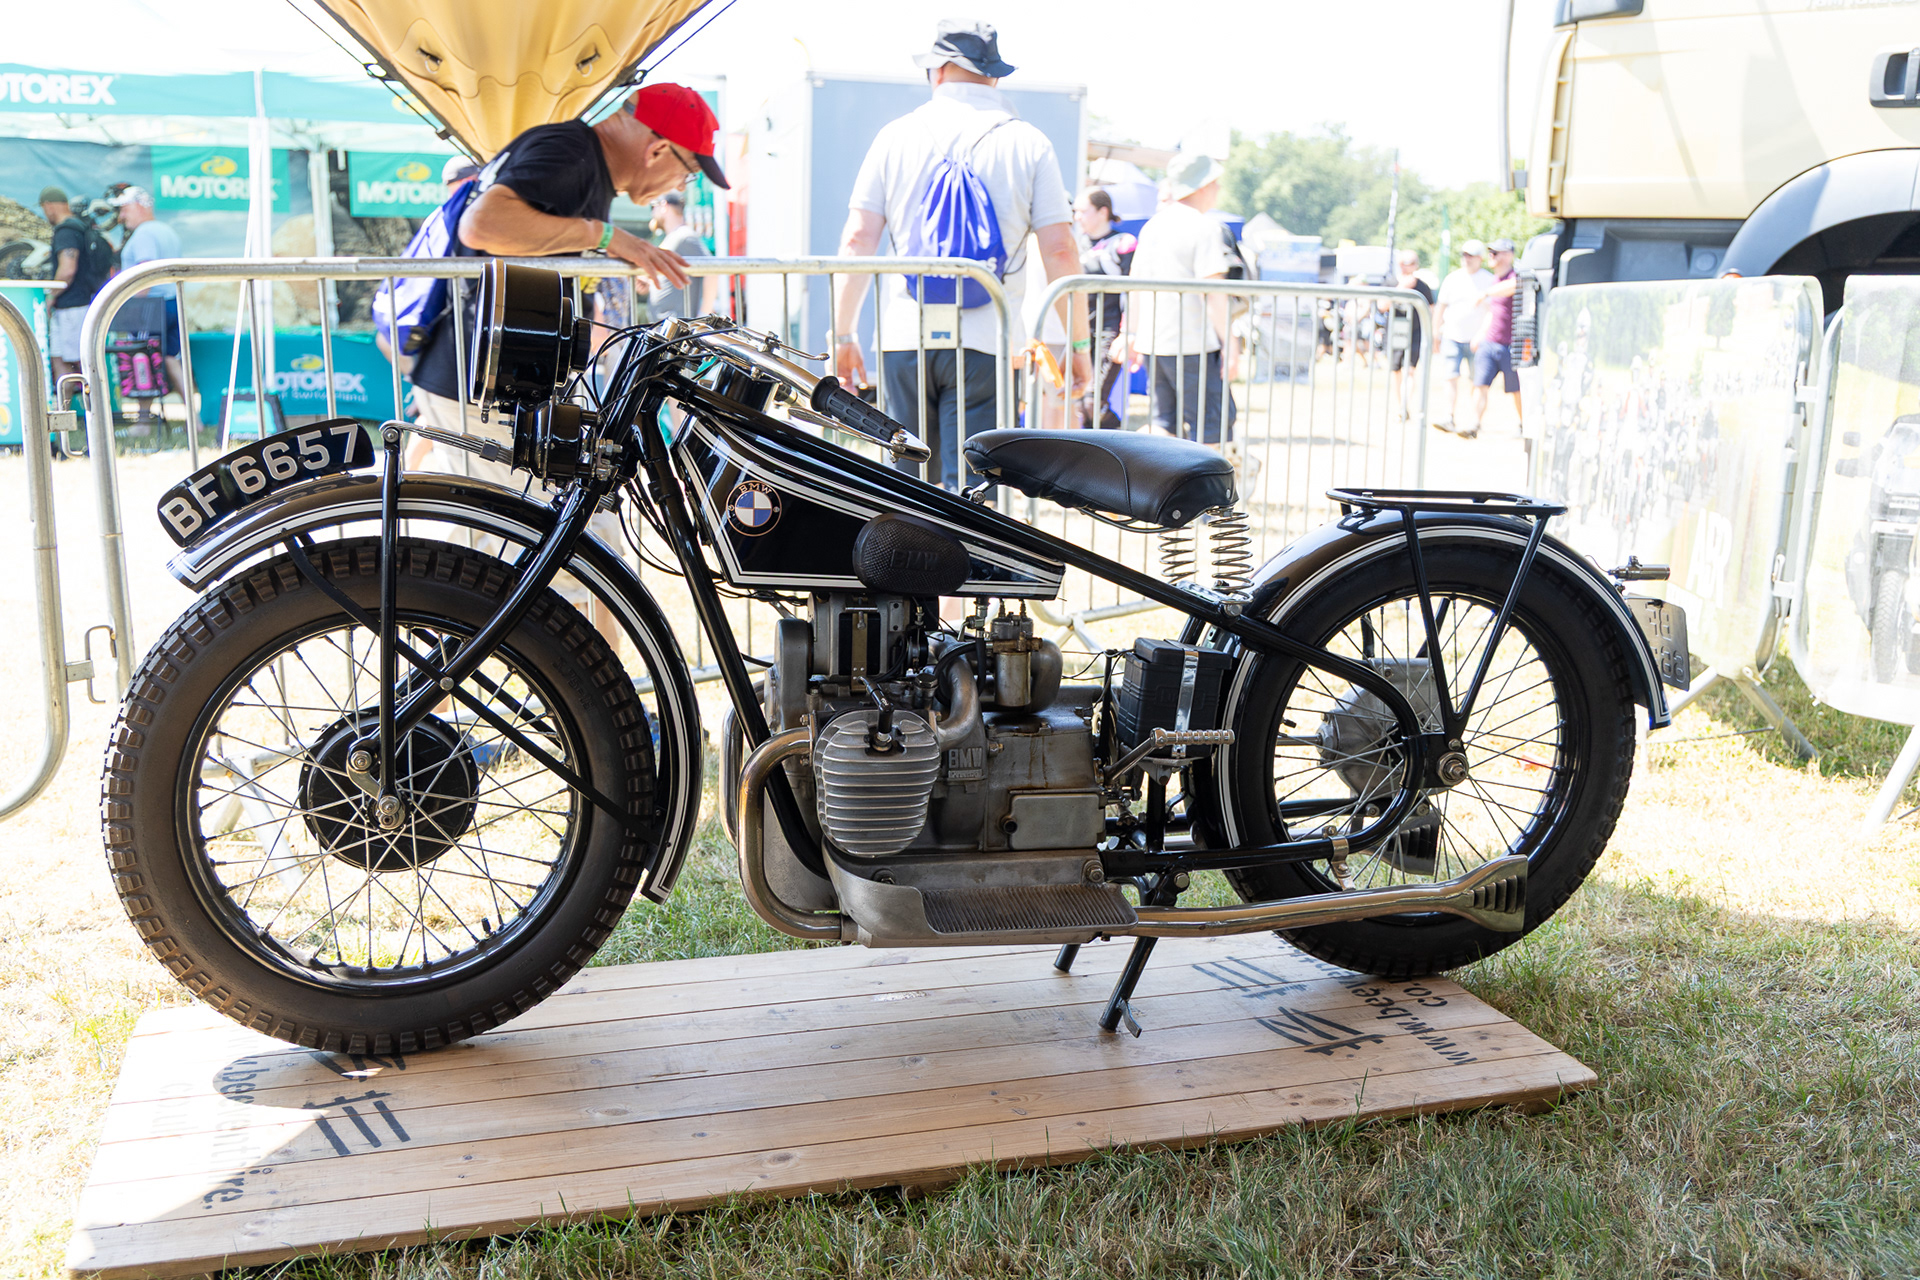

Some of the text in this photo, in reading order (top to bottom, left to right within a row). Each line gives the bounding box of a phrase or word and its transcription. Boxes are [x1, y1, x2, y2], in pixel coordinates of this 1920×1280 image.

[264, 371, 365, 393] OTOREX
[159, 424, 358, 538] BF 6657
[739, 482, 772, 494] BMW
[889, 549, 940, 571] BMW
[949, 747, 982, 768] BMW
